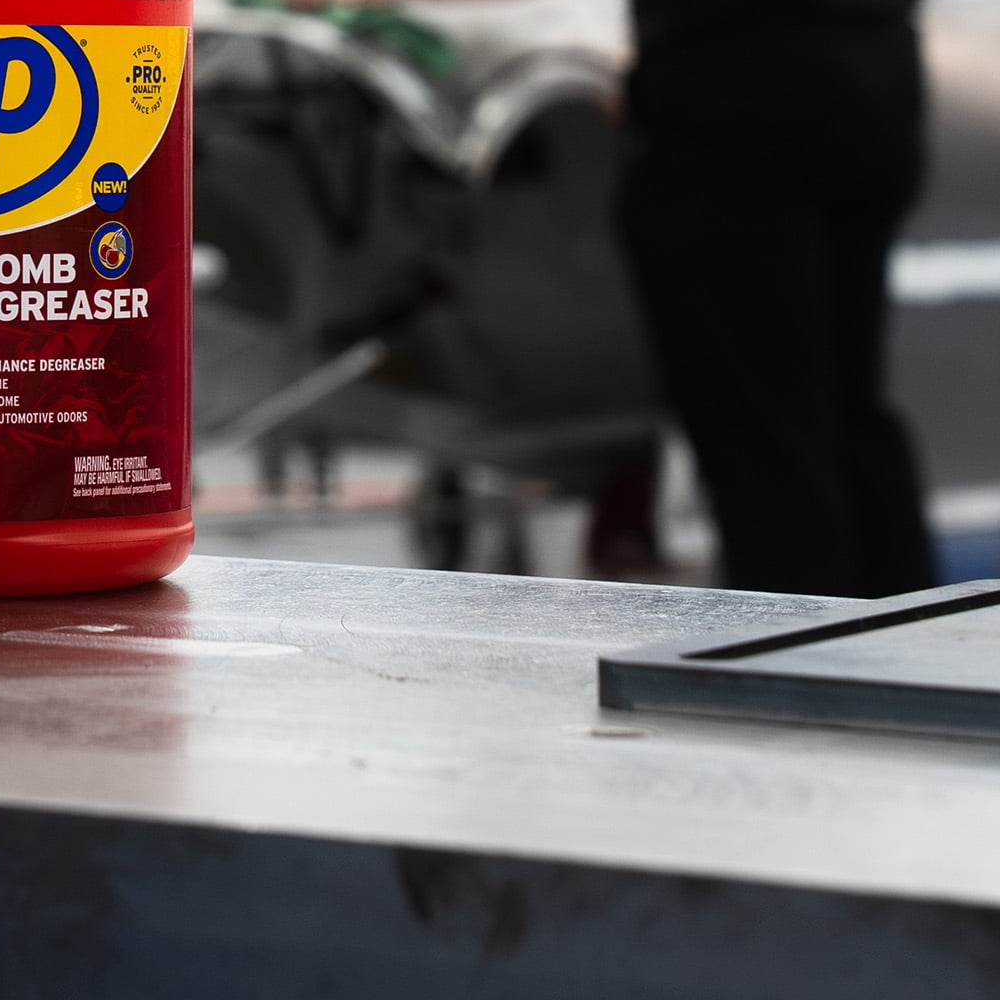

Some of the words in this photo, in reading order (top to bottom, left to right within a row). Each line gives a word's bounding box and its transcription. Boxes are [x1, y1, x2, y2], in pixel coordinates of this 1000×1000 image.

[133, 44, 161, 59] TRUSTED
[133, 66, 161, 83] PRO
[133, 85, 161, 94] QUALITY
[130, 97, 150, 115] SINCE
[151, 96, 163, 113] 1937
[93, 181, 127, 194] NEW!
[39, 357, 105, 371] DEGREASER
[57, 411, 88, 424] ODORS
[74, 455, 111, 473] WARNING.
[113, 458, 123, 470] EYE
[73, 473, 87, 485] MAY
[88, 472, 96, 485] BE
[97, 471, 124, 484] HARMFUL
[125, 470, 131, 483] IF
[73, 488, 81, 497] See
